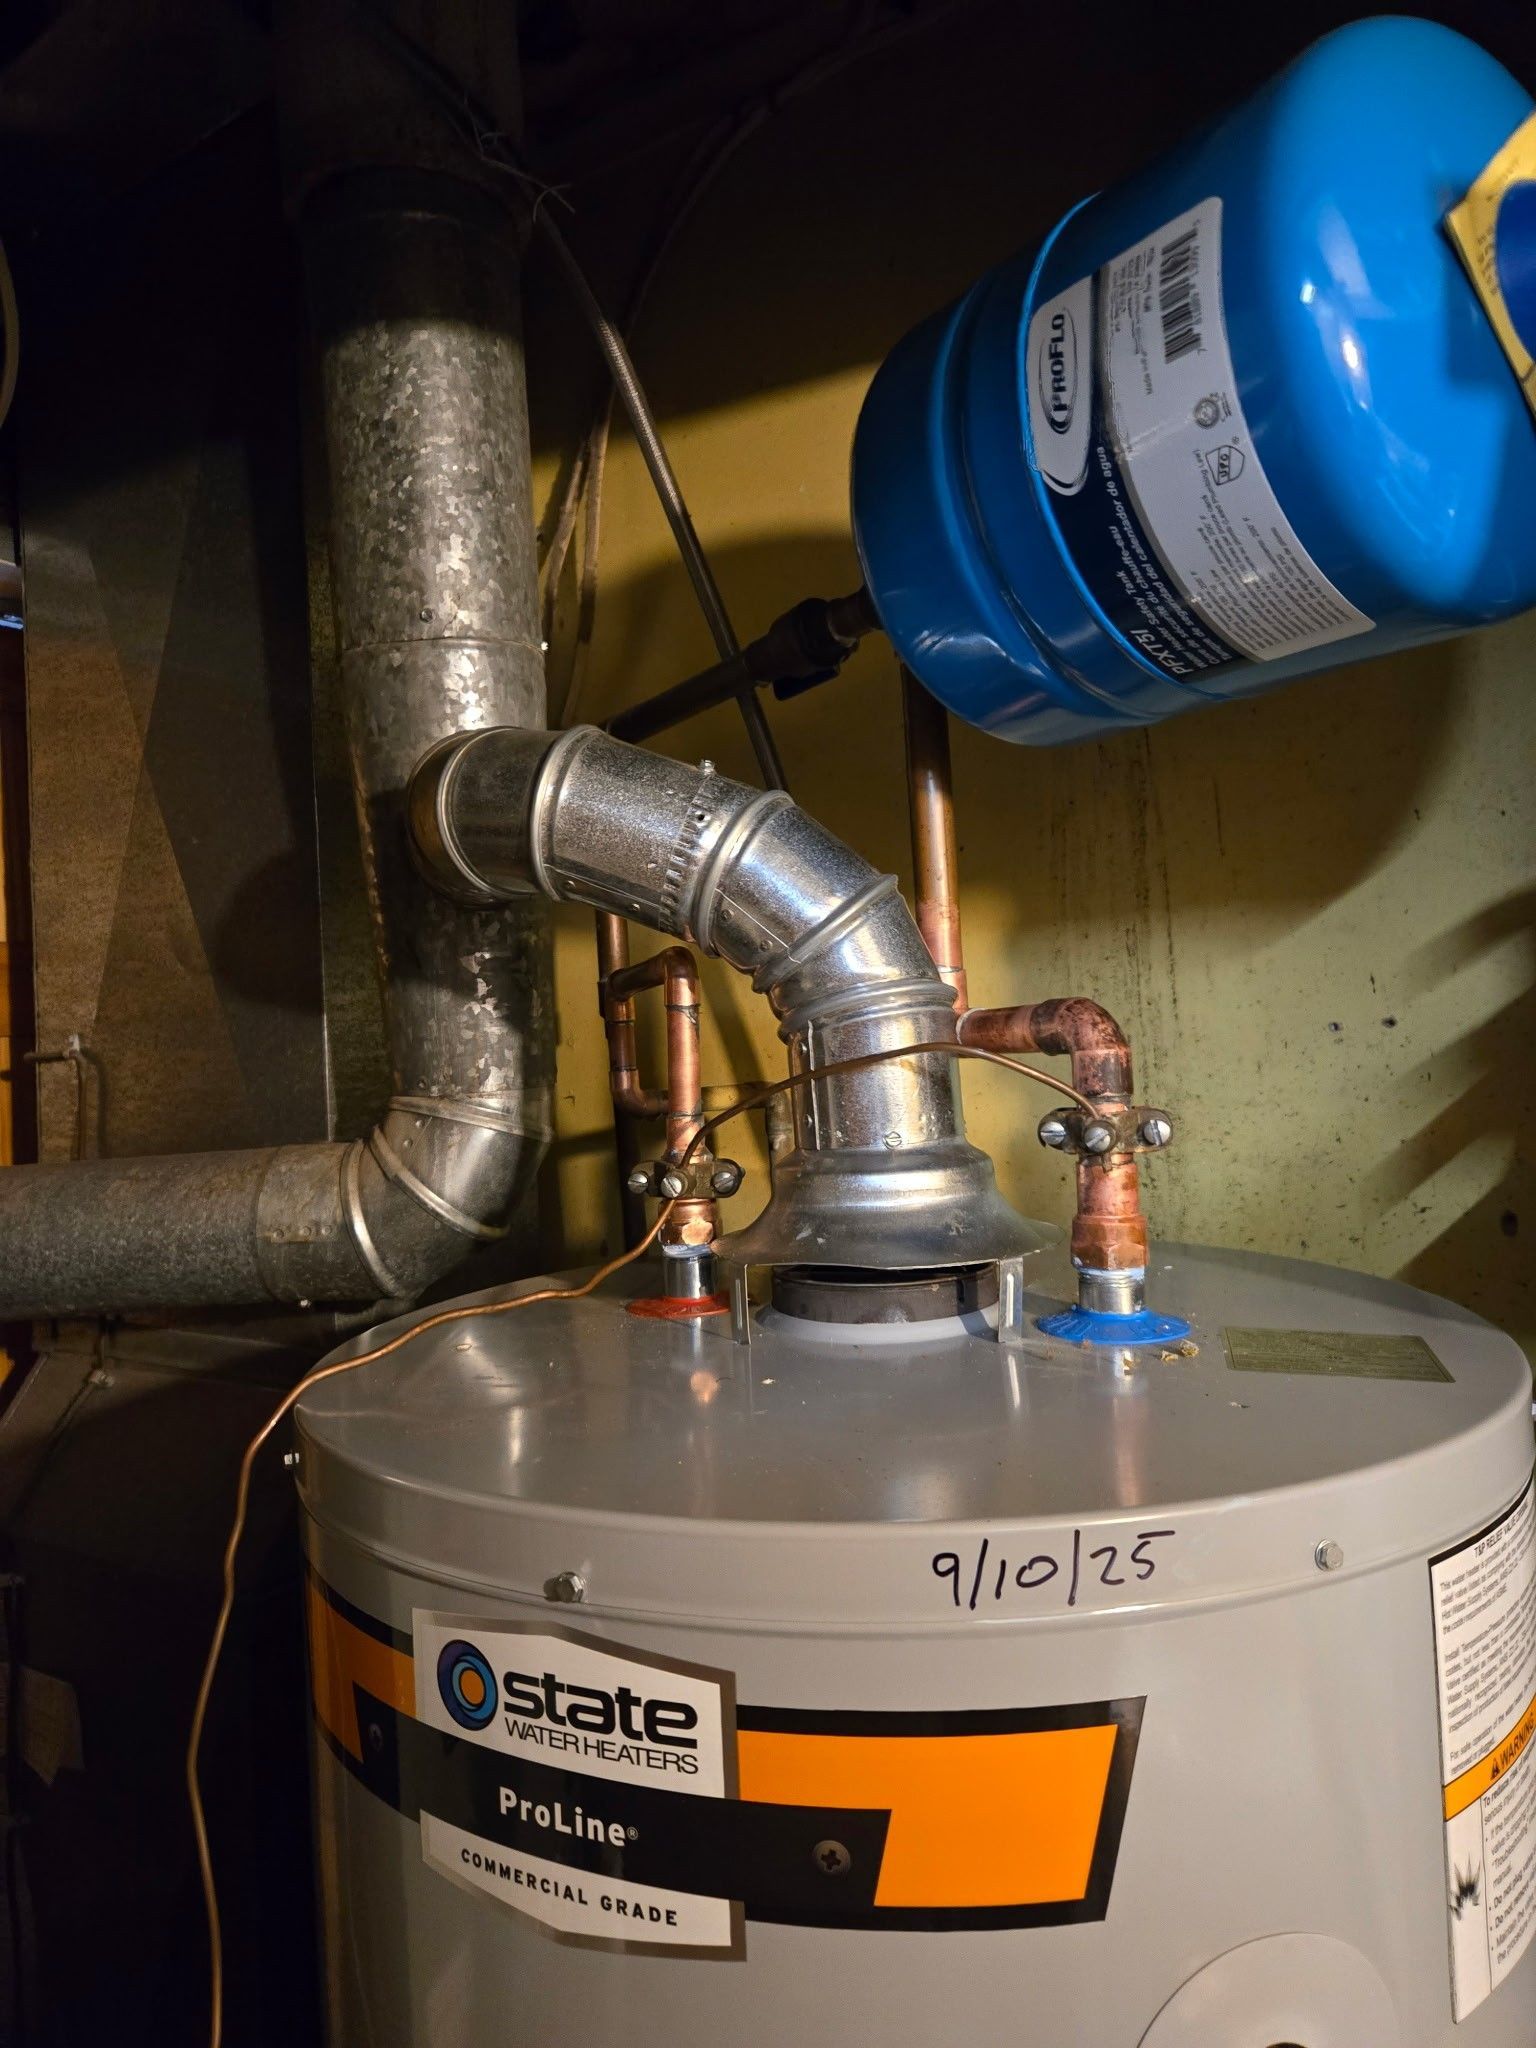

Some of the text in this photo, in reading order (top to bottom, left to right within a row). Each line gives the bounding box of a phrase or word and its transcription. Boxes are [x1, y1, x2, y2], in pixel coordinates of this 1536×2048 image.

[1049, 313, 1067, 412] PROFLO
[1095, 445, 1113, 477] agua
[1105, 480, 1118, 497] de
[1112, 498, 1147, 561] calentador
[1107, 525, 1149, 591] chauffe-eau
[1141, 561, 1158, 580] del
[1115, 569, 1136, 595] Tank
[1143, 588, 1158, 604] du
[1153, 580, 1194, 627] seguridad
[1131, 595, 1159, 624] Safety
[932, 1529, 1175, 1610] 9/10/25
[503, 1671, 698, 1750] state
[504, 1717, 699, 1774] WATER HEATERS
[1499, 1714, 1535, 1769] WARNING
[461, 1848, 678, 1926] COMMERCIAL GRADE
[1494, 1892, 1502, 1908] Do
[1495, 1912, 1503, 1929] Do
